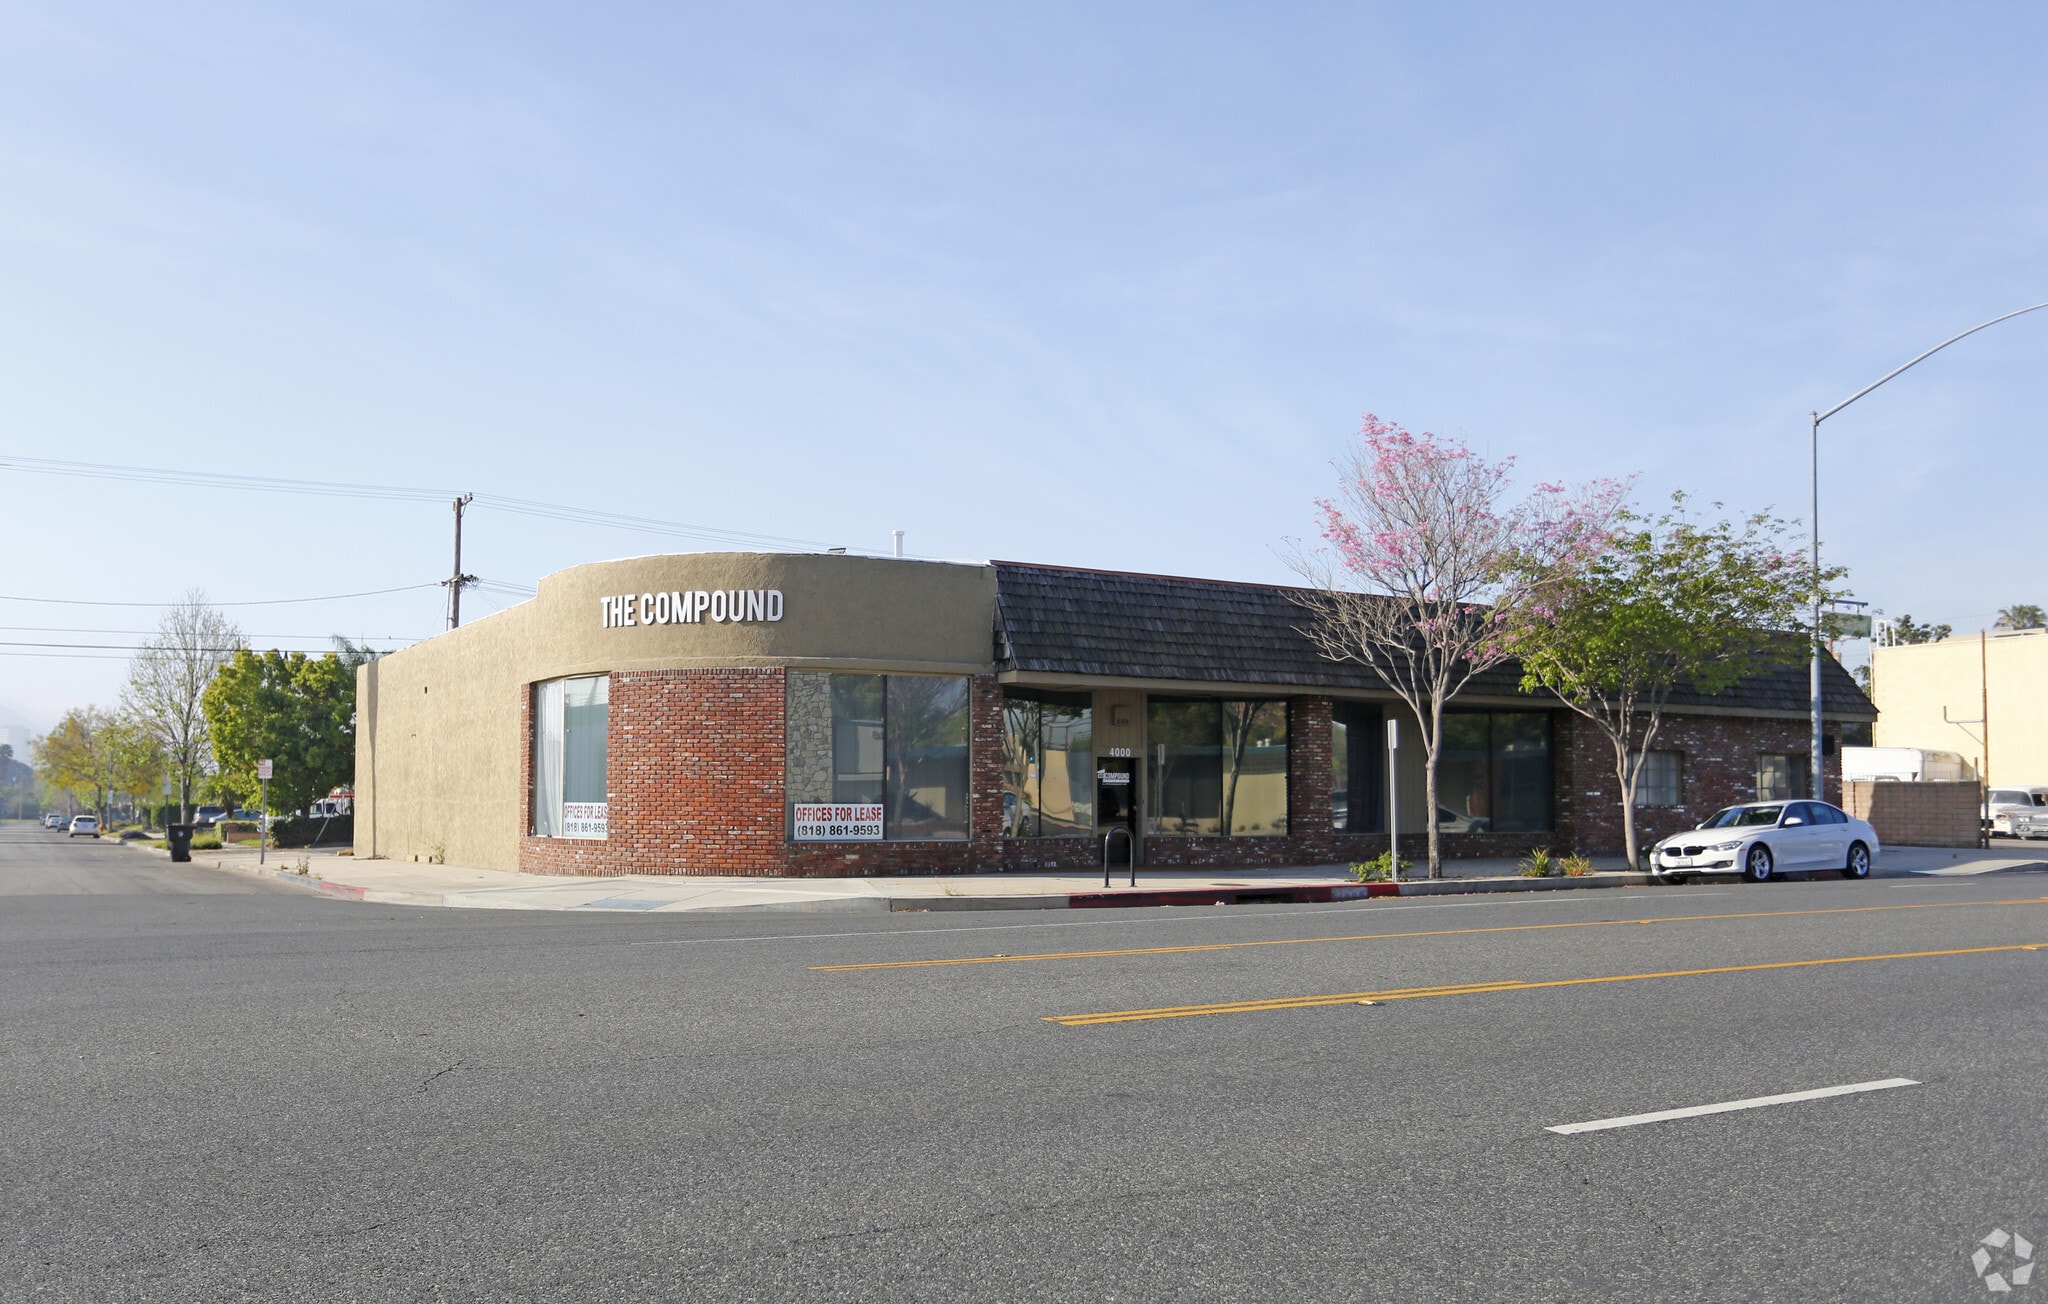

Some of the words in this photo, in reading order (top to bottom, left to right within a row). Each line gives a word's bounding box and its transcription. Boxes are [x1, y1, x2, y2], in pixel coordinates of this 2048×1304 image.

[600, 594, 636, 628] THE
[640, 589, 784, 625] COMPOUND
[1110, 748, 1130, 757] 4000
[564, 805, 583, 819] OFFICES
[584, 805, 594, 819] FOR
[595, 805, 608, 819] LEAS
[796, 807, 833, 822] OFFICES
[835, 807, 853, 822] FOR
[854, 807, 882, 822] LEASE
[565, 822, 579, 833] (818)
[797, 825, 826, 837] (818)
[829, 825, 881, 836] 861-9593
